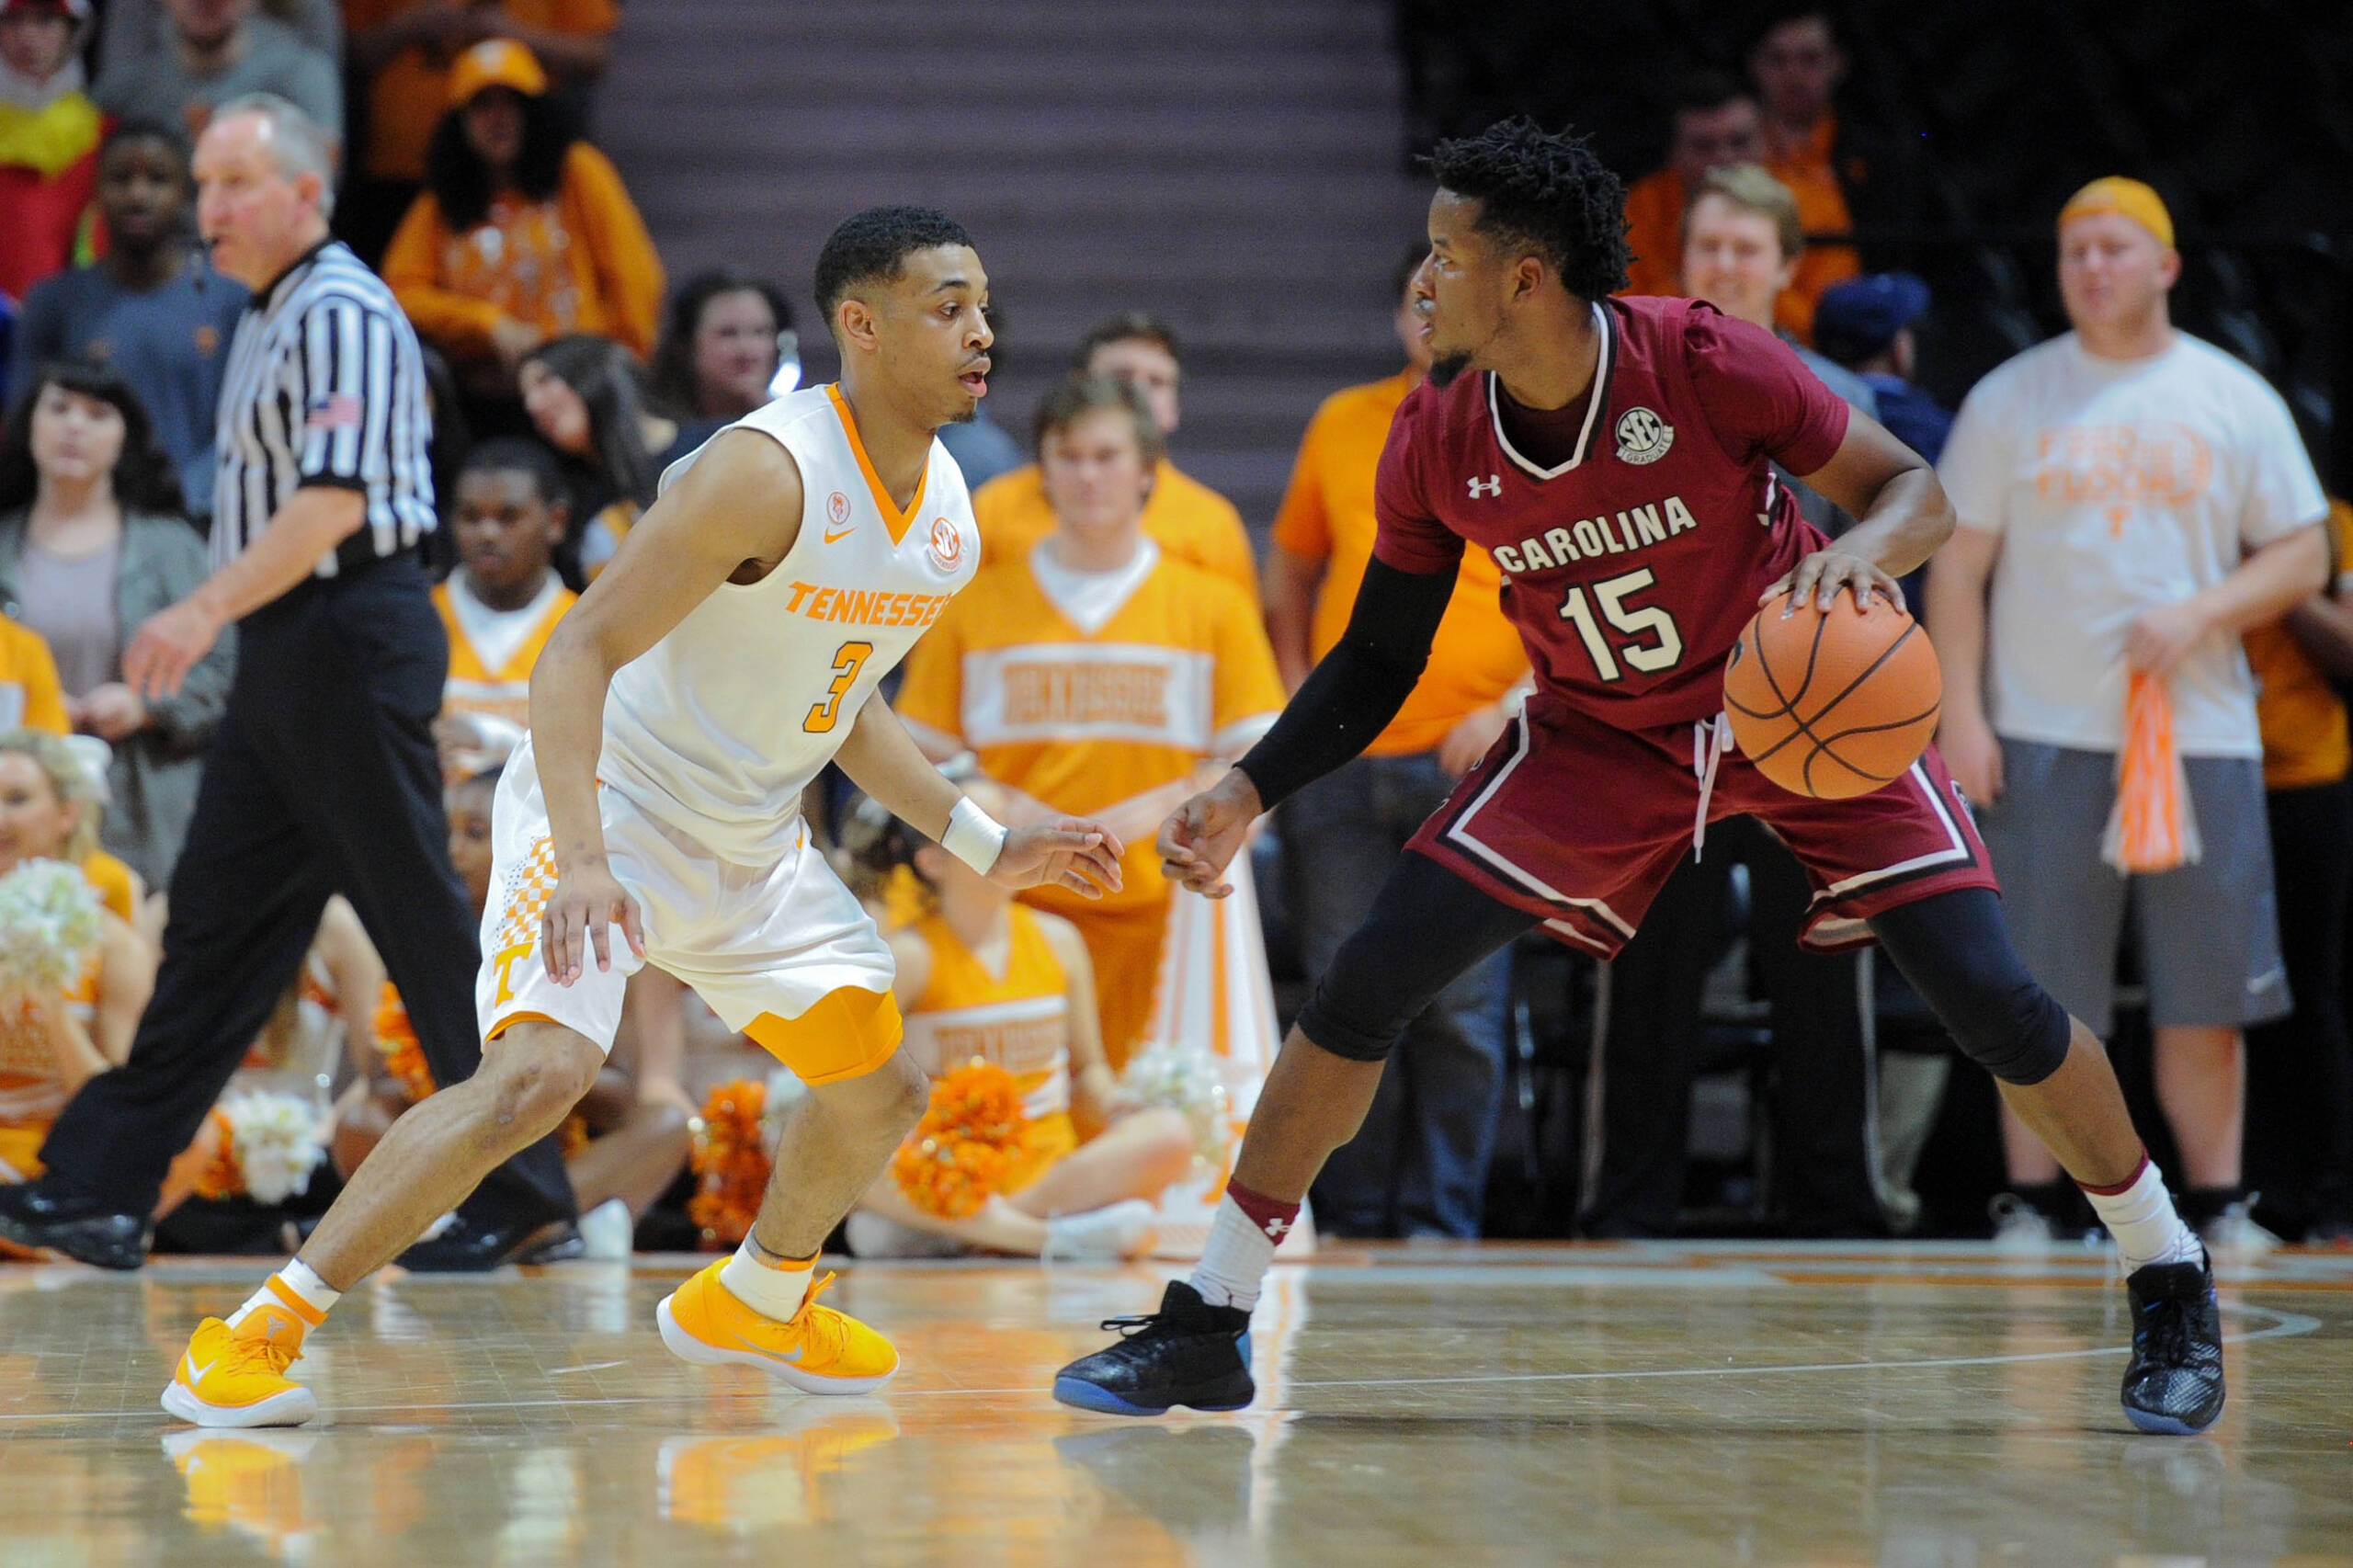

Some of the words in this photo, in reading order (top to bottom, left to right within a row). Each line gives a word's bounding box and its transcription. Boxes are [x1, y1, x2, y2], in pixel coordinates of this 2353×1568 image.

[1619, 411, 1660, 451] SEC
[1493, 495, 1699, 574] CAROLINA
[1559, 566, 1683, 681] 15
[802, 641, 873, 733] 3
[494, 942, 534, 1008] T
